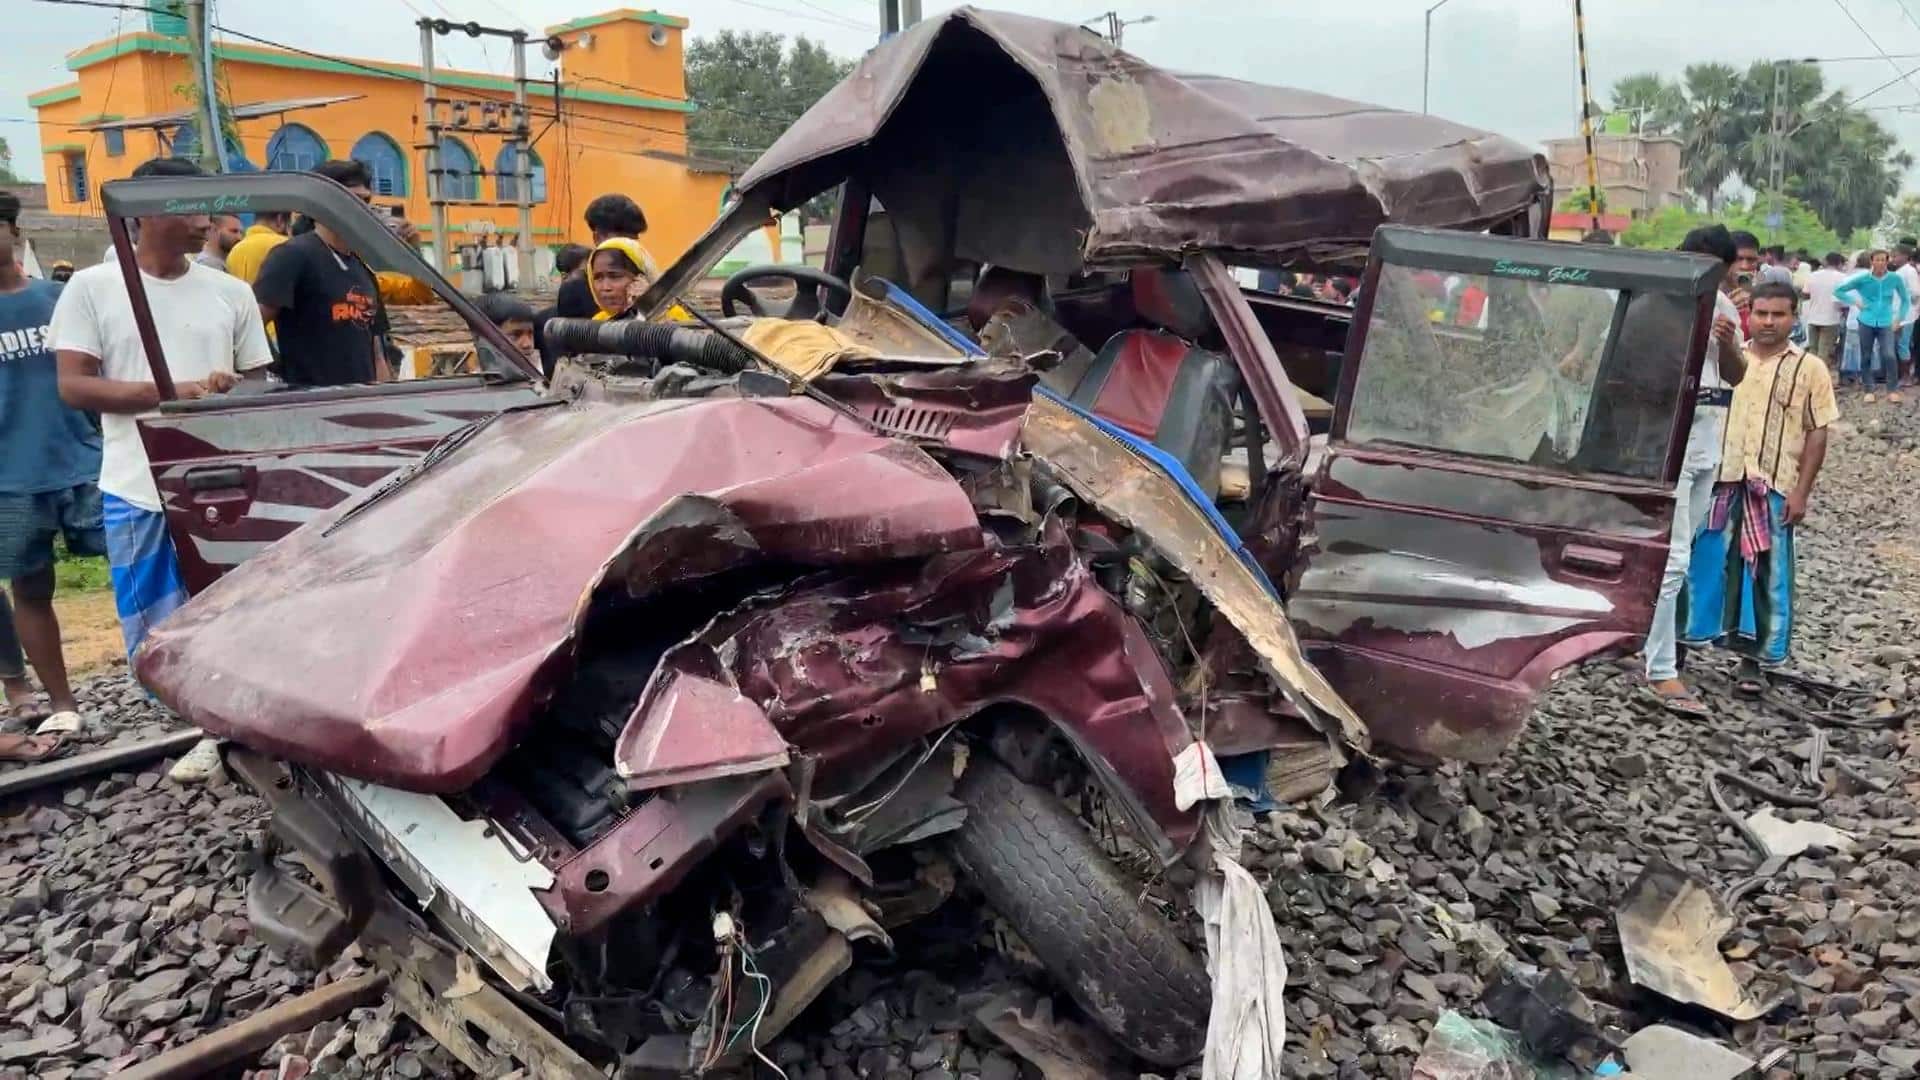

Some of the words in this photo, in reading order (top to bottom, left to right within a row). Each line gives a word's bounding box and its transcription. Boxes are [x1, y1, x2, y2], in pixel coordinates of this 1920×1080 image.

[214, 194, 249, 211] Gold
[1493, 259, 1541, 277] Sumo
[1548, 266, 1590, 282] Gold
[0, 325, 49, 353] DIES
